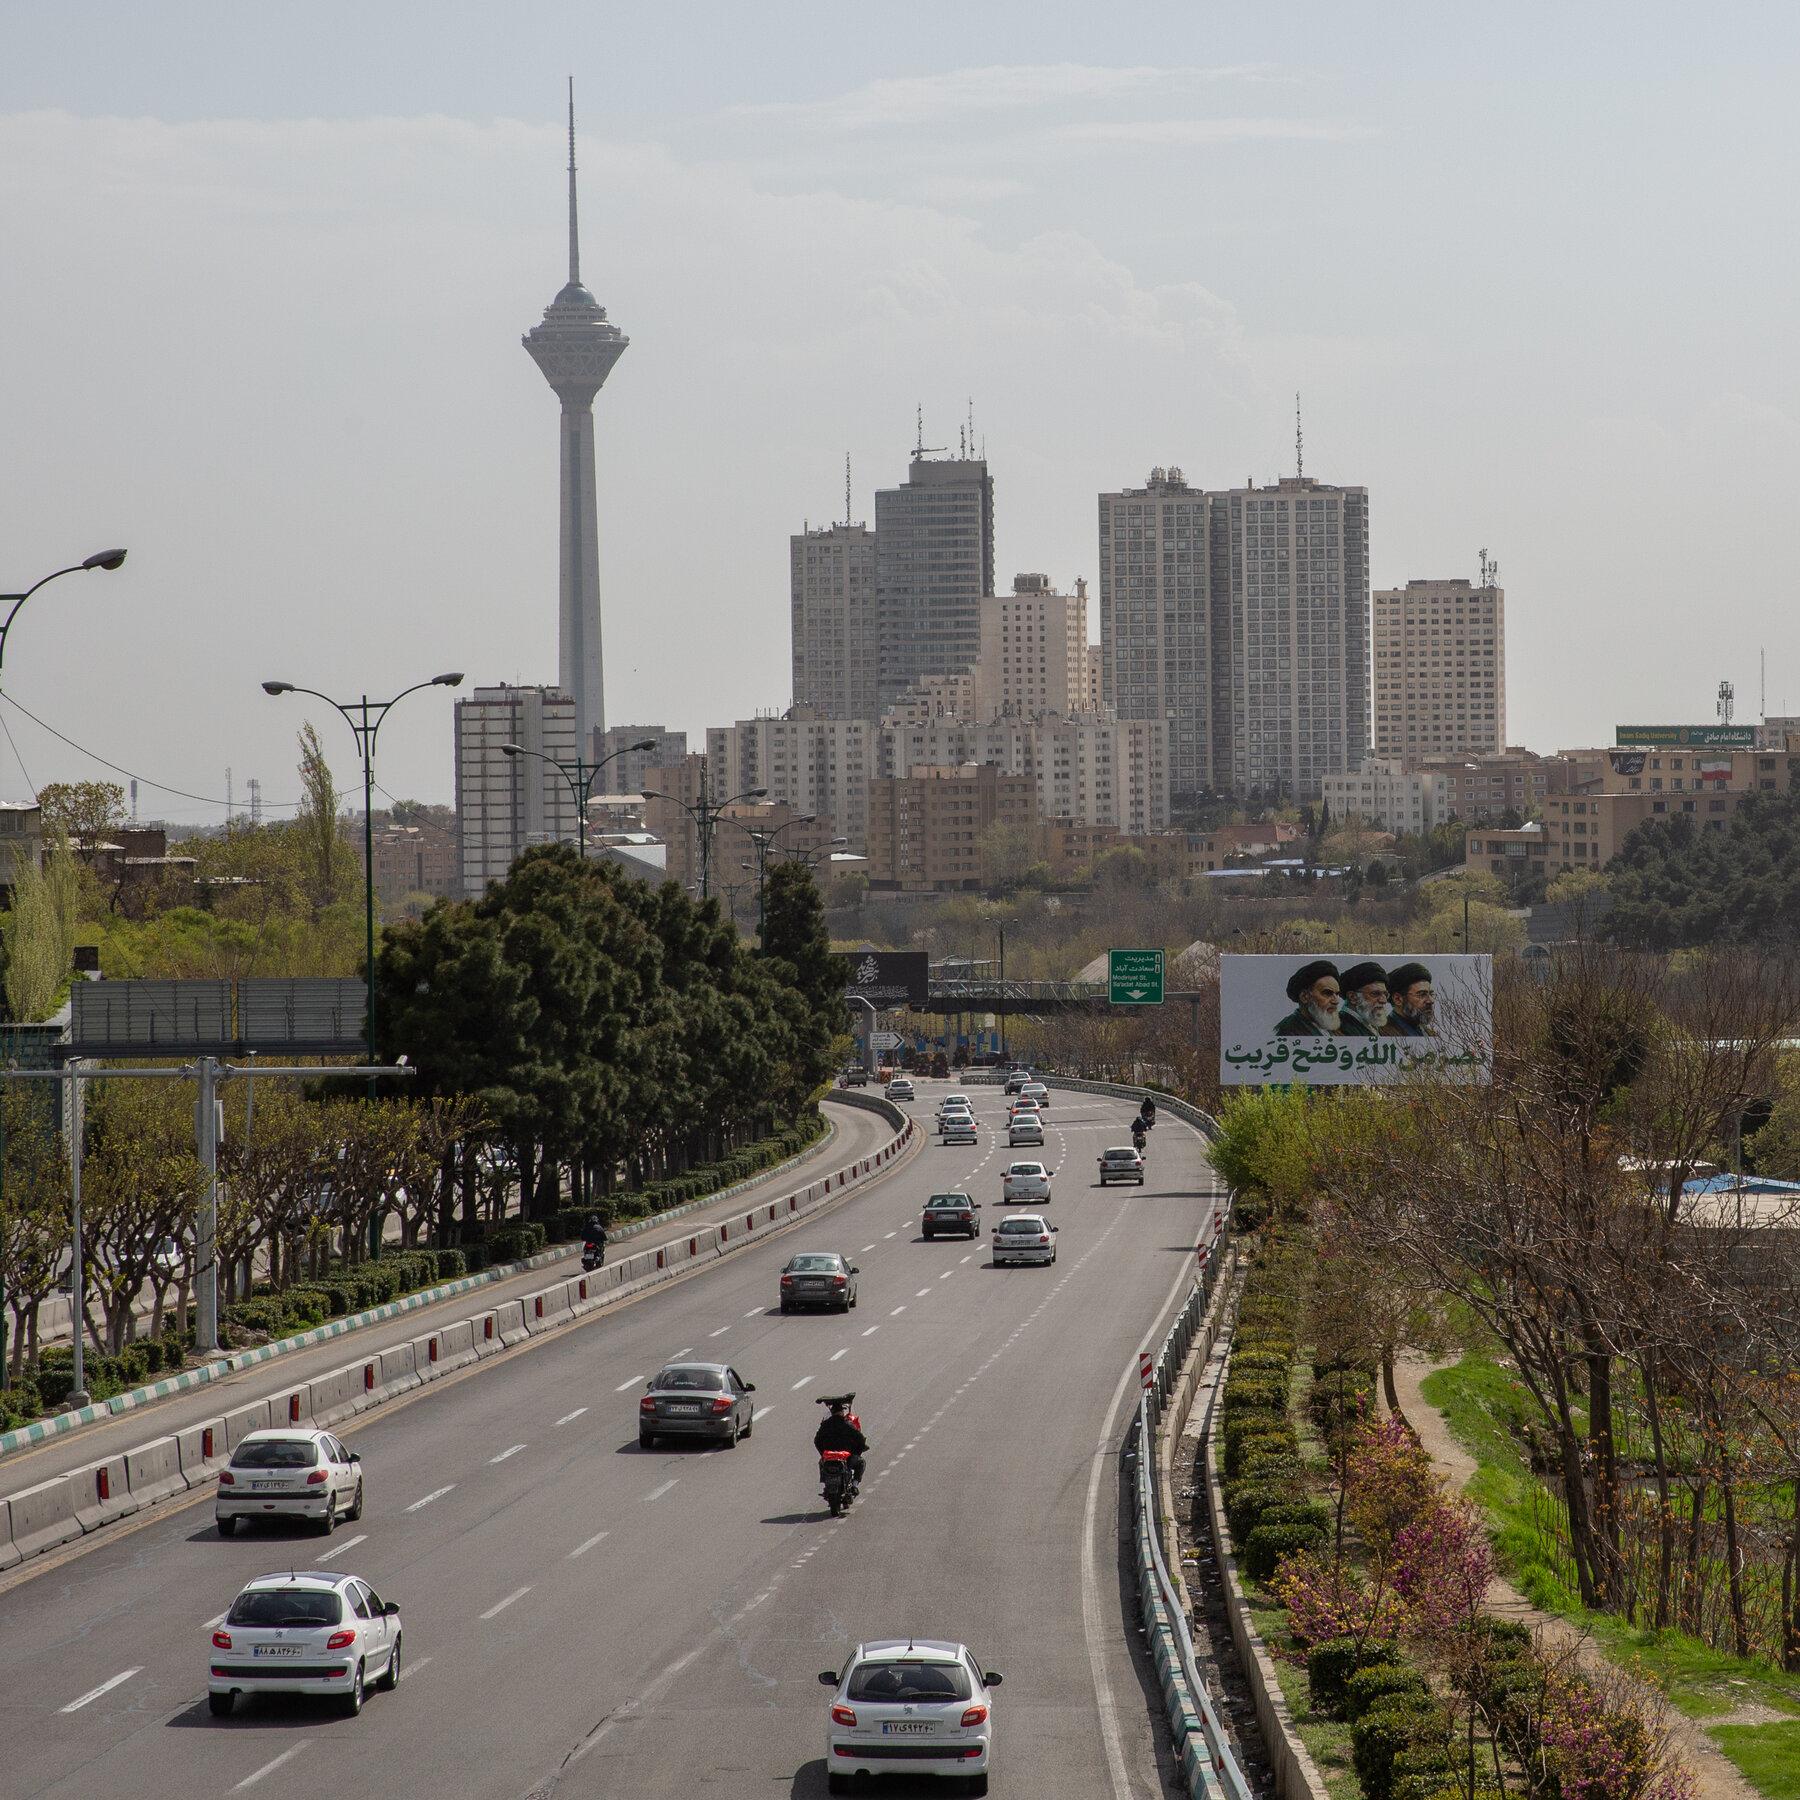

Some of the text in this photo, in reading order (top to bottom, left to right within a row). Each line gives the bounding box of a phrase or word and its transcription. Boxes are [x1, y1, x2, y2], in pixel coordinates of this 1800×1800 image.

[1704, 731, 1720, 743] صادق
[1720, 731, 1731, 743] امام
[1731, 730, 1752, 741] دانشگاه
[1115, 964, 1128, 973] آباد
